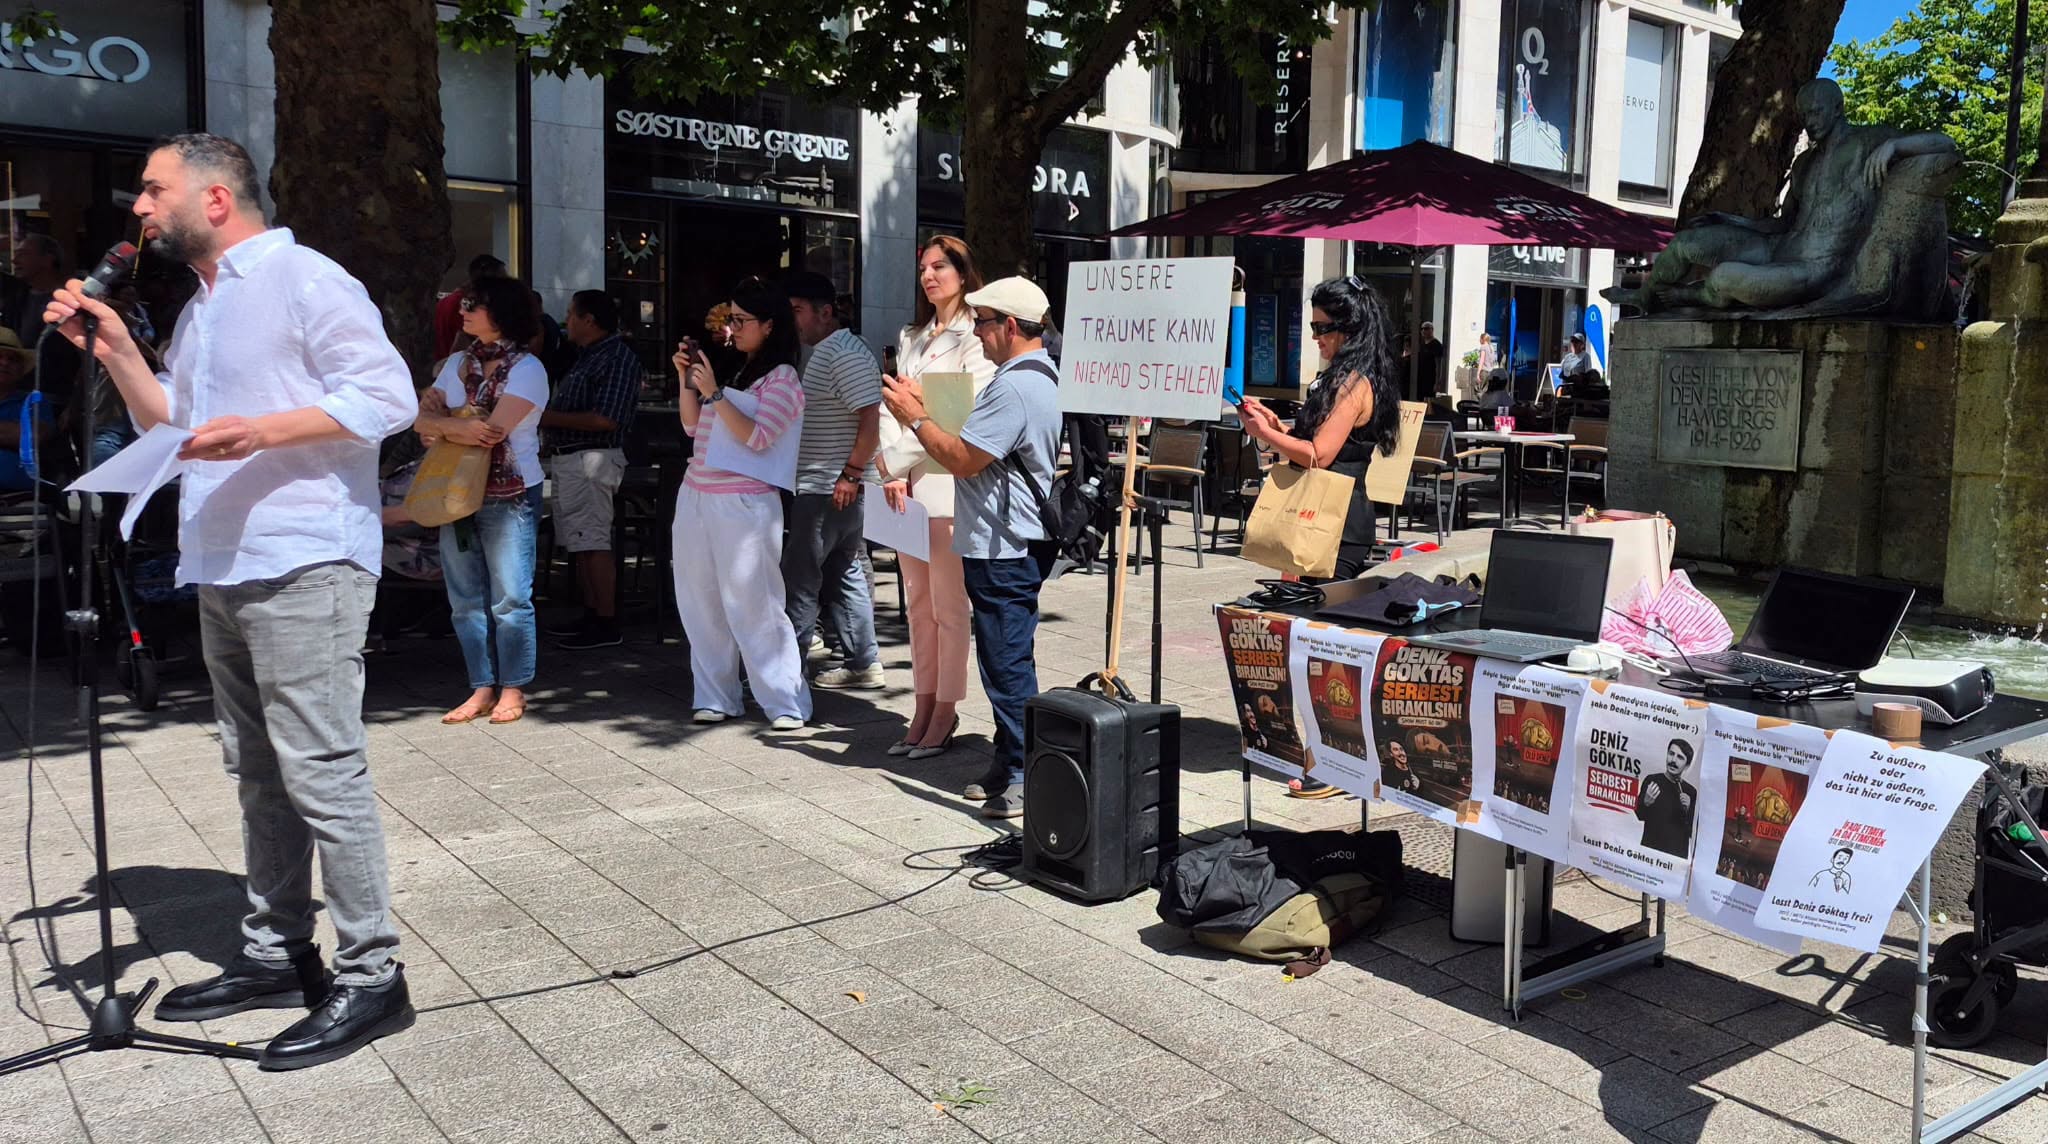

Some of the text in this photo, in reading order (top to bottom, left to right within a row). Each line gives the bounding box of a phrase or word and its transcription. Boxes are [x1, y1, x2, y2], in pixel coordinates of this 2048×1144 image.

[1275, 32, 1290, 133] RESERV
[616, 109, 850, 162] SØSTRENE GRENE
[1086, 264, 1176, 291] UNSERE
[1080, 315, 1215, 343] TRÄUME KANN
[1138, 363, 1220, 395] STEHLEN
[1670, 365, 1790, 387] GESTIFTET VON
[1671, 386, 1703, 406] DEN
[1678, 407, 1775, 430] HAMBURGS
[1690, 430, 1761, 451] 1914-1926
[1233, 650, 1284, 667] SERBEST
[1235, 666, 1286, 682] BIRAKILSIN!
[1382, 681, 1463, 703] SERBEST
[1610, 692, 1648, 708] Komedyen
[1381, 699, 1462, 719] BIRAKILSIN!
[1590, 728, 1629, 752] DENİZ
[1756, 739, 1766, 748] bir
[1793, 747, 1822, 761] istiyoru
[1589, 747, 1641, 777] GÖKTAŞ
[1772, 751, 1782, 760] bir
[1870, 751, 1926, 771] Zu äußern
[1590, 770, 1632, 792] SERBEST
[1842, 770, 1926, 797] nicht zu äußern,
[1880, 767, 1906, 779] oder
[1589, 784, 1636, 807] BIRAKILSIN!
[1825, 780, 1938, 812] das ist hier die Frage.
[1583, 835, 1673, 871] Lasst Deniz Göktaş frei!
[1771, 895, 1792, 908] Lasst
[1793, 899, 1816, 913] Deniz
[1818, 904, 1850, 921] Göktaş
[1850, 910, 1873, 924] frei!
